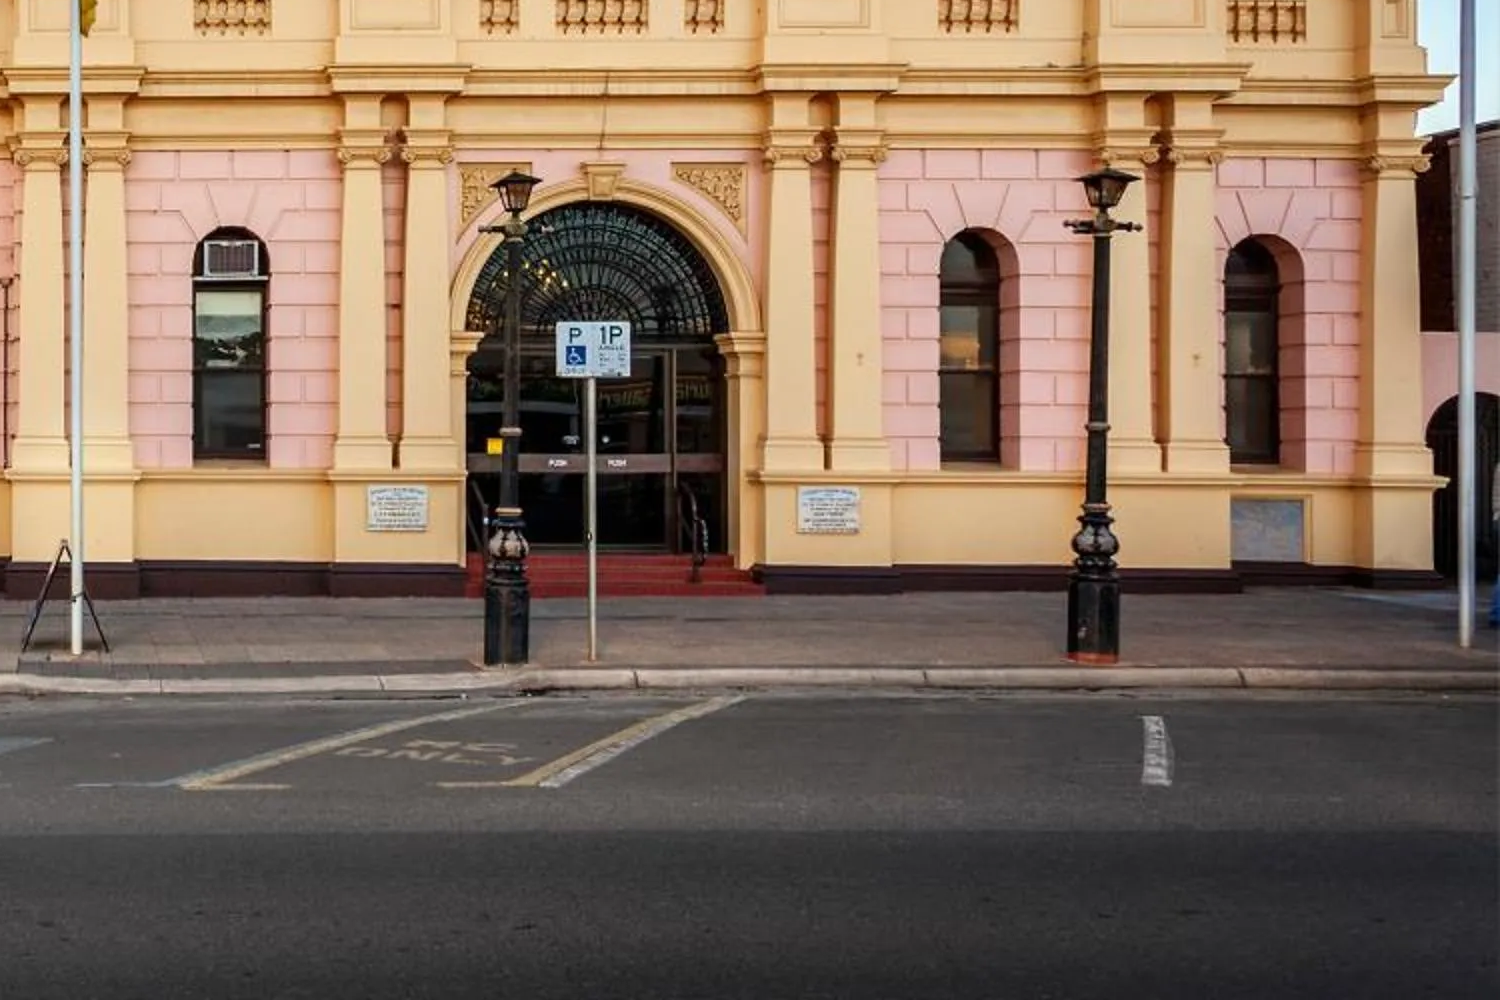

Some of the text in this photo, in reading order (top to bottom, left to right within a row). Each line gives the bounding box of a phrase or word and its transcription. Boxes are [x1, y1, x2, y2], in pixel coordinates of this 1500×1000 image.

[569, 327, 583, 344] P
[600, 325, 623, 345] 1P
[334, 747, 535, 765] ONLY
